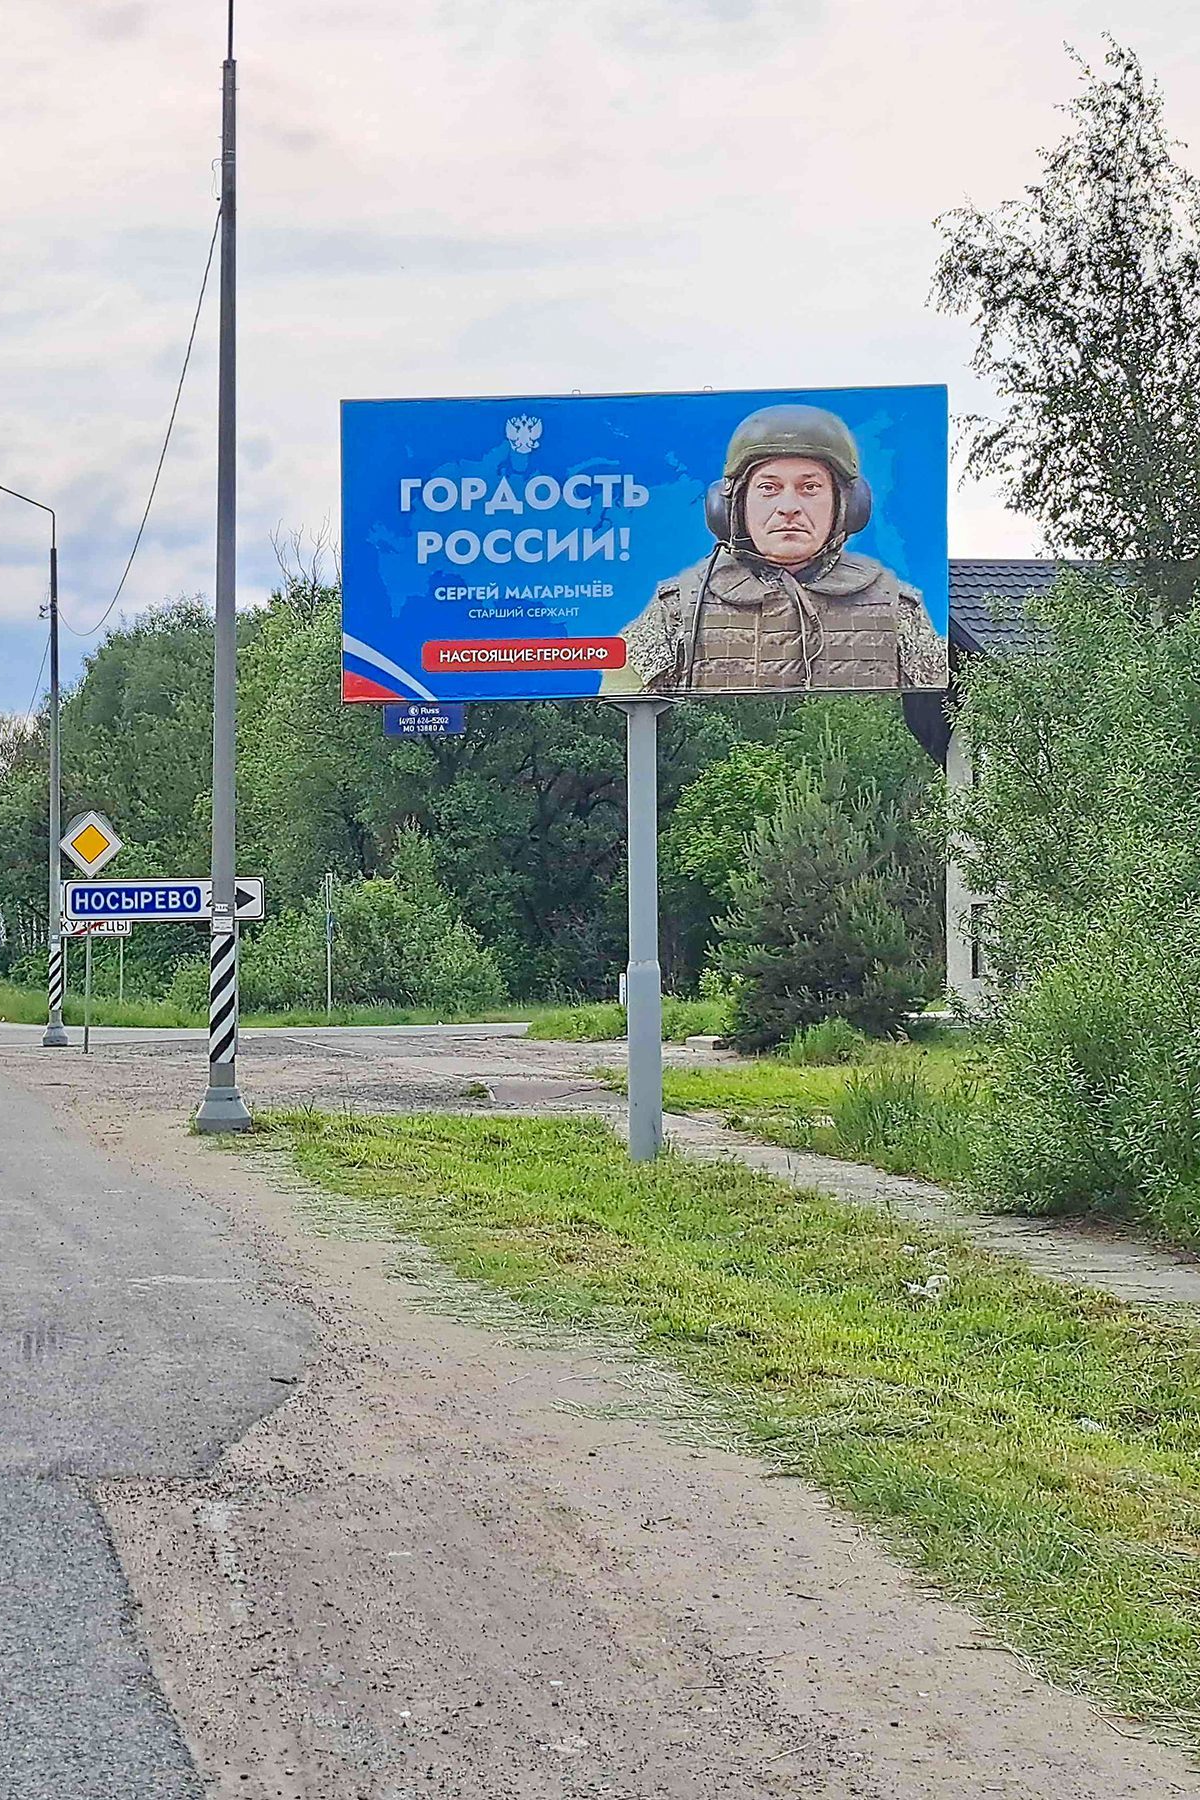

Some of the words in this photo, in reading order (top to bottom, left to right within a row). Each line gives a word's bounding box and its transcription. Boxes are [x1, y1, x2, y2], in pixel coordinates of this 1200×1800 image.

[400, 474, 650, 515] ГОРДОСТЬ
[417, 527, 631, 565] РОССИИ!
[434, 582, 499, 601] СЕРГЕЙ
[505, 580, 614, 600] МАГАРЫЧЁВ
[468, 606, 524, 619] СТАРШИЙ
[527, 607, 580, 618] СЕРЖАНТ
[439, 647, 609, 664] НАСТОЯЩИЕ-ГЕРОИ.РФ
[420, 707, 440, 715] Russ
[75, 889, 197, 911] НОСЫРЕВО
